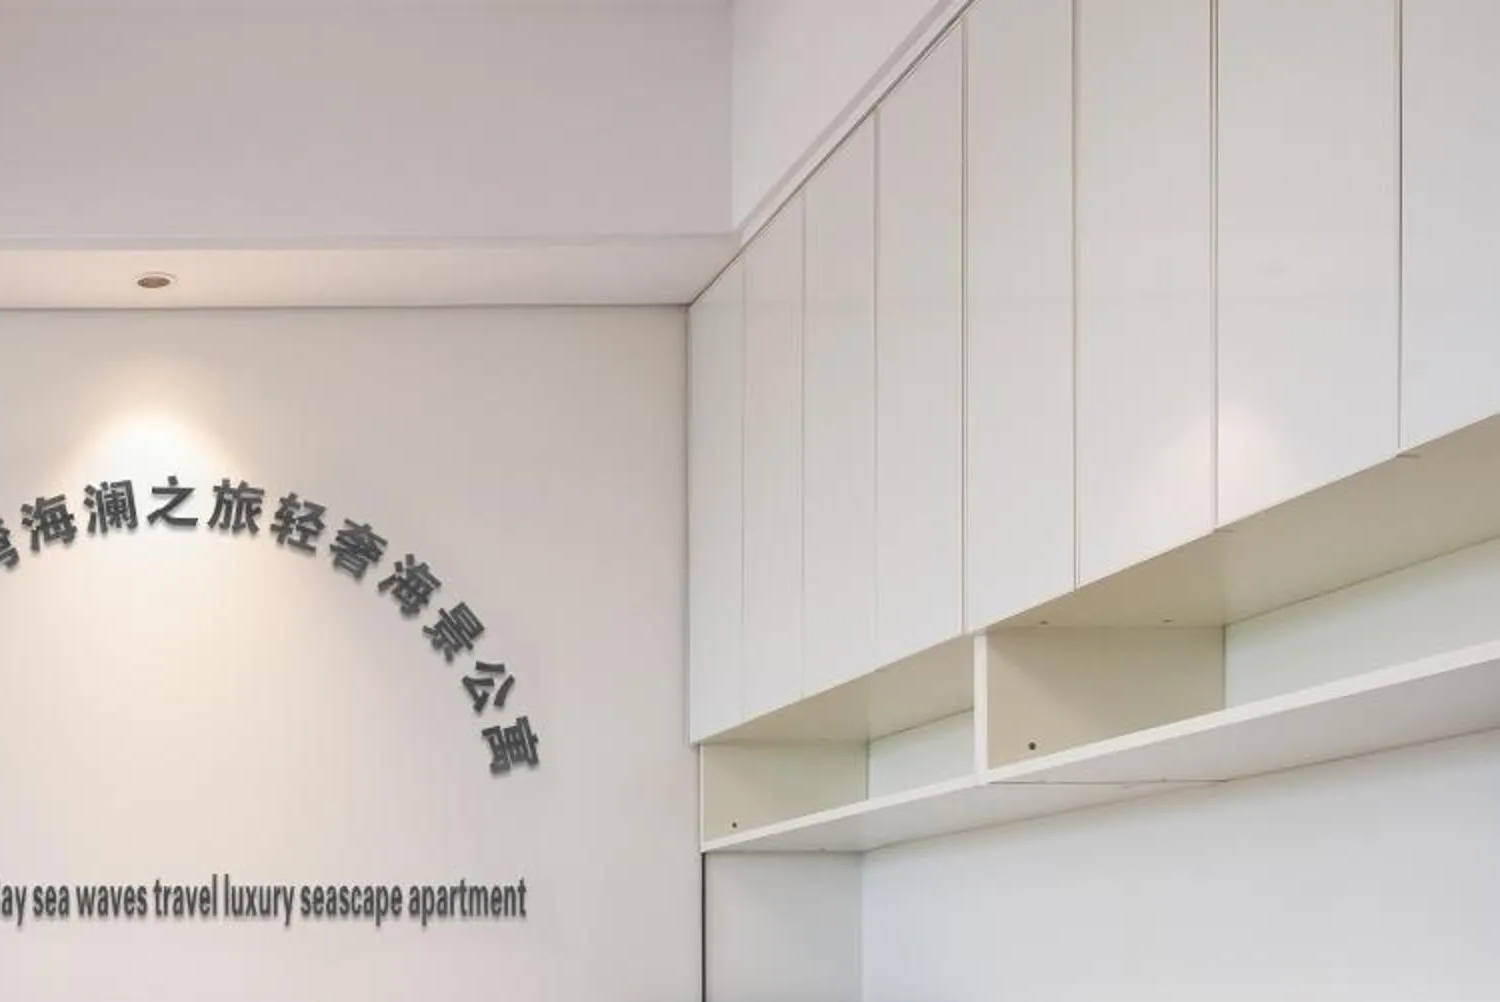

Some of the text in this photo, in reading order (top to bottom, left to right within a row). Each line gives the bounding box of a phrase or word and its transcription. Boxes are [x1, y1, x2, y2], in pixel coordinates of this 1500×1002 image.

[33, 884, 70, 918] sea
[75, 884, 147, 918] waves
[153, 873, 217, 918] travel
[224, 873, 295, 927] luxury
[300, 884, 403, 927] seascape
[408, 878, 527, 927] apartment
